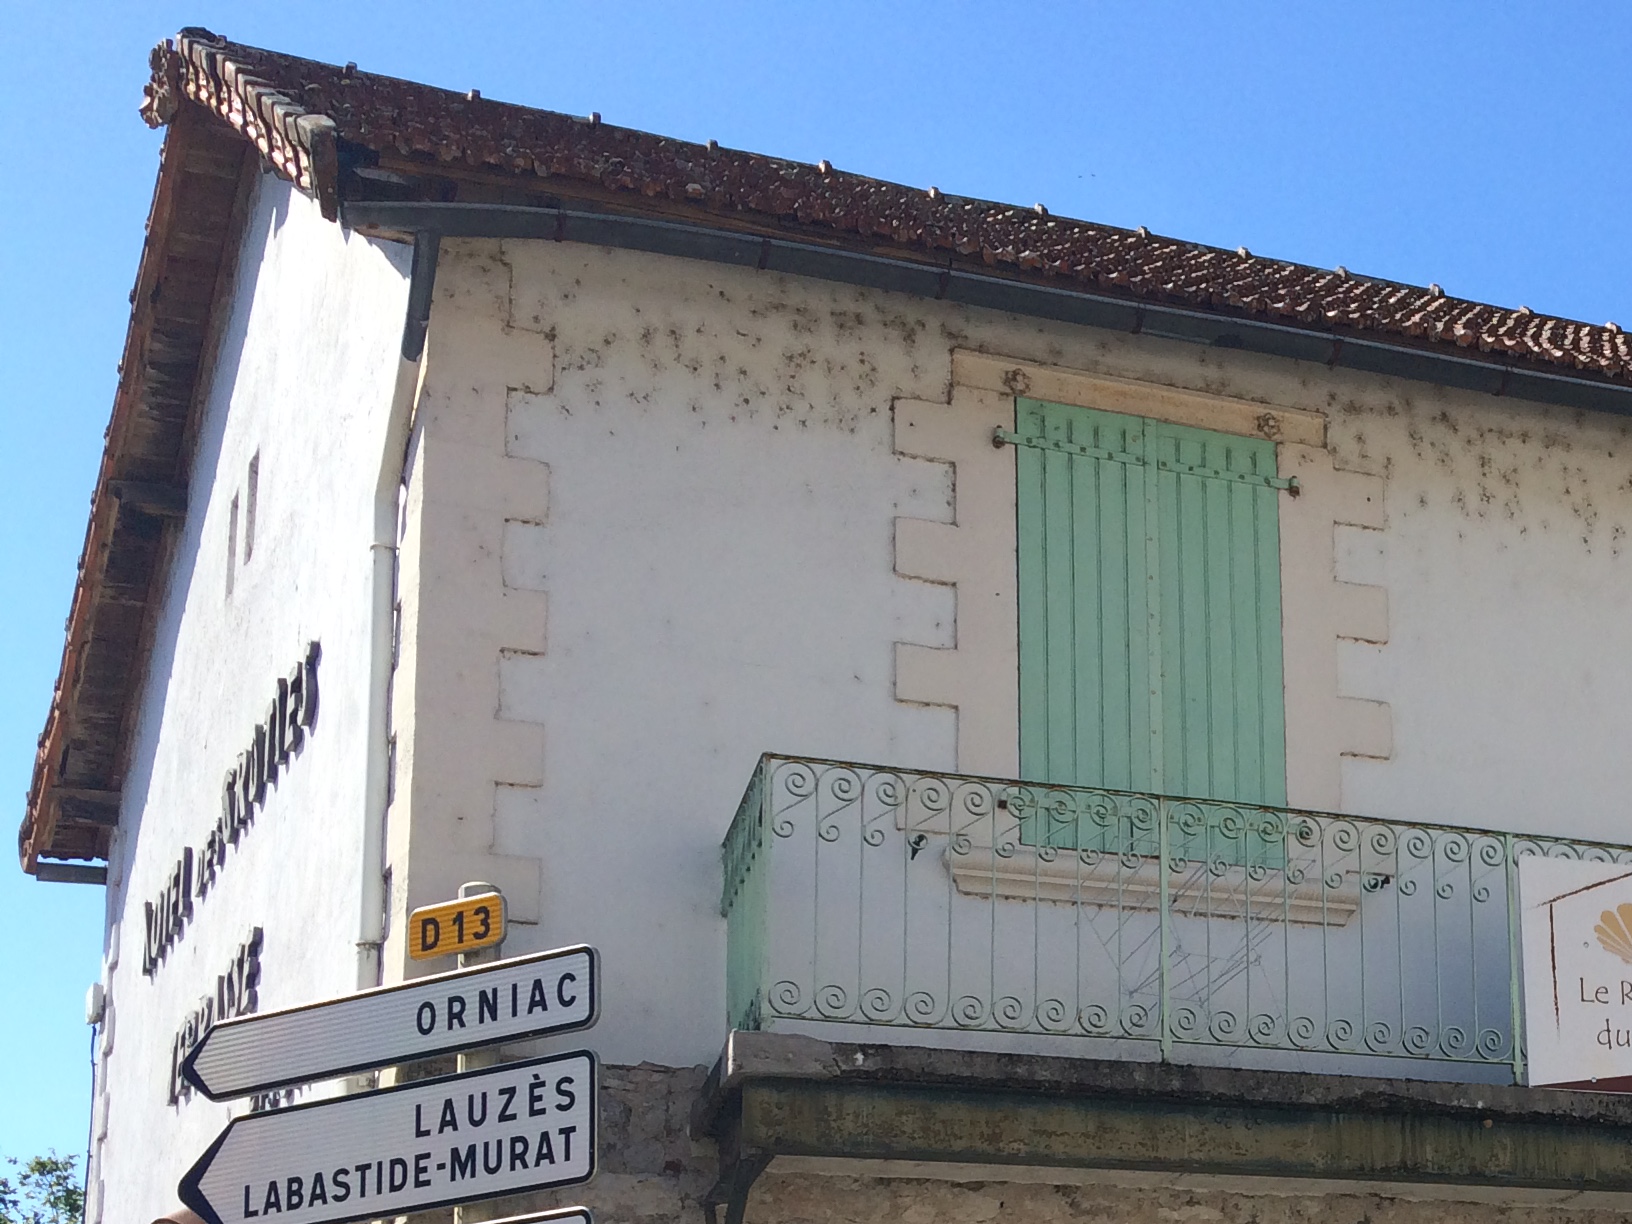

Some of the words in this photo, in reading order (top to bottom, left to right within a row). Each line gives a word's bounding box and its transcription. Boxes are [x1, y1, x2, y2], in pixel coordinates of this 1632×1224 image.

[420, 916, 441, 952] D
[452, 906, 491, 942] 13
[416, 971, 578, 1036] ORNIAC
[1579, 976, 1609, 1004] Le
[1596, 1018, 1631, 1050] du
[414, 1074, 577, 1139] LAUZÈS
[242, 1126, 578, 1220] LABASTIDE-MURAT
